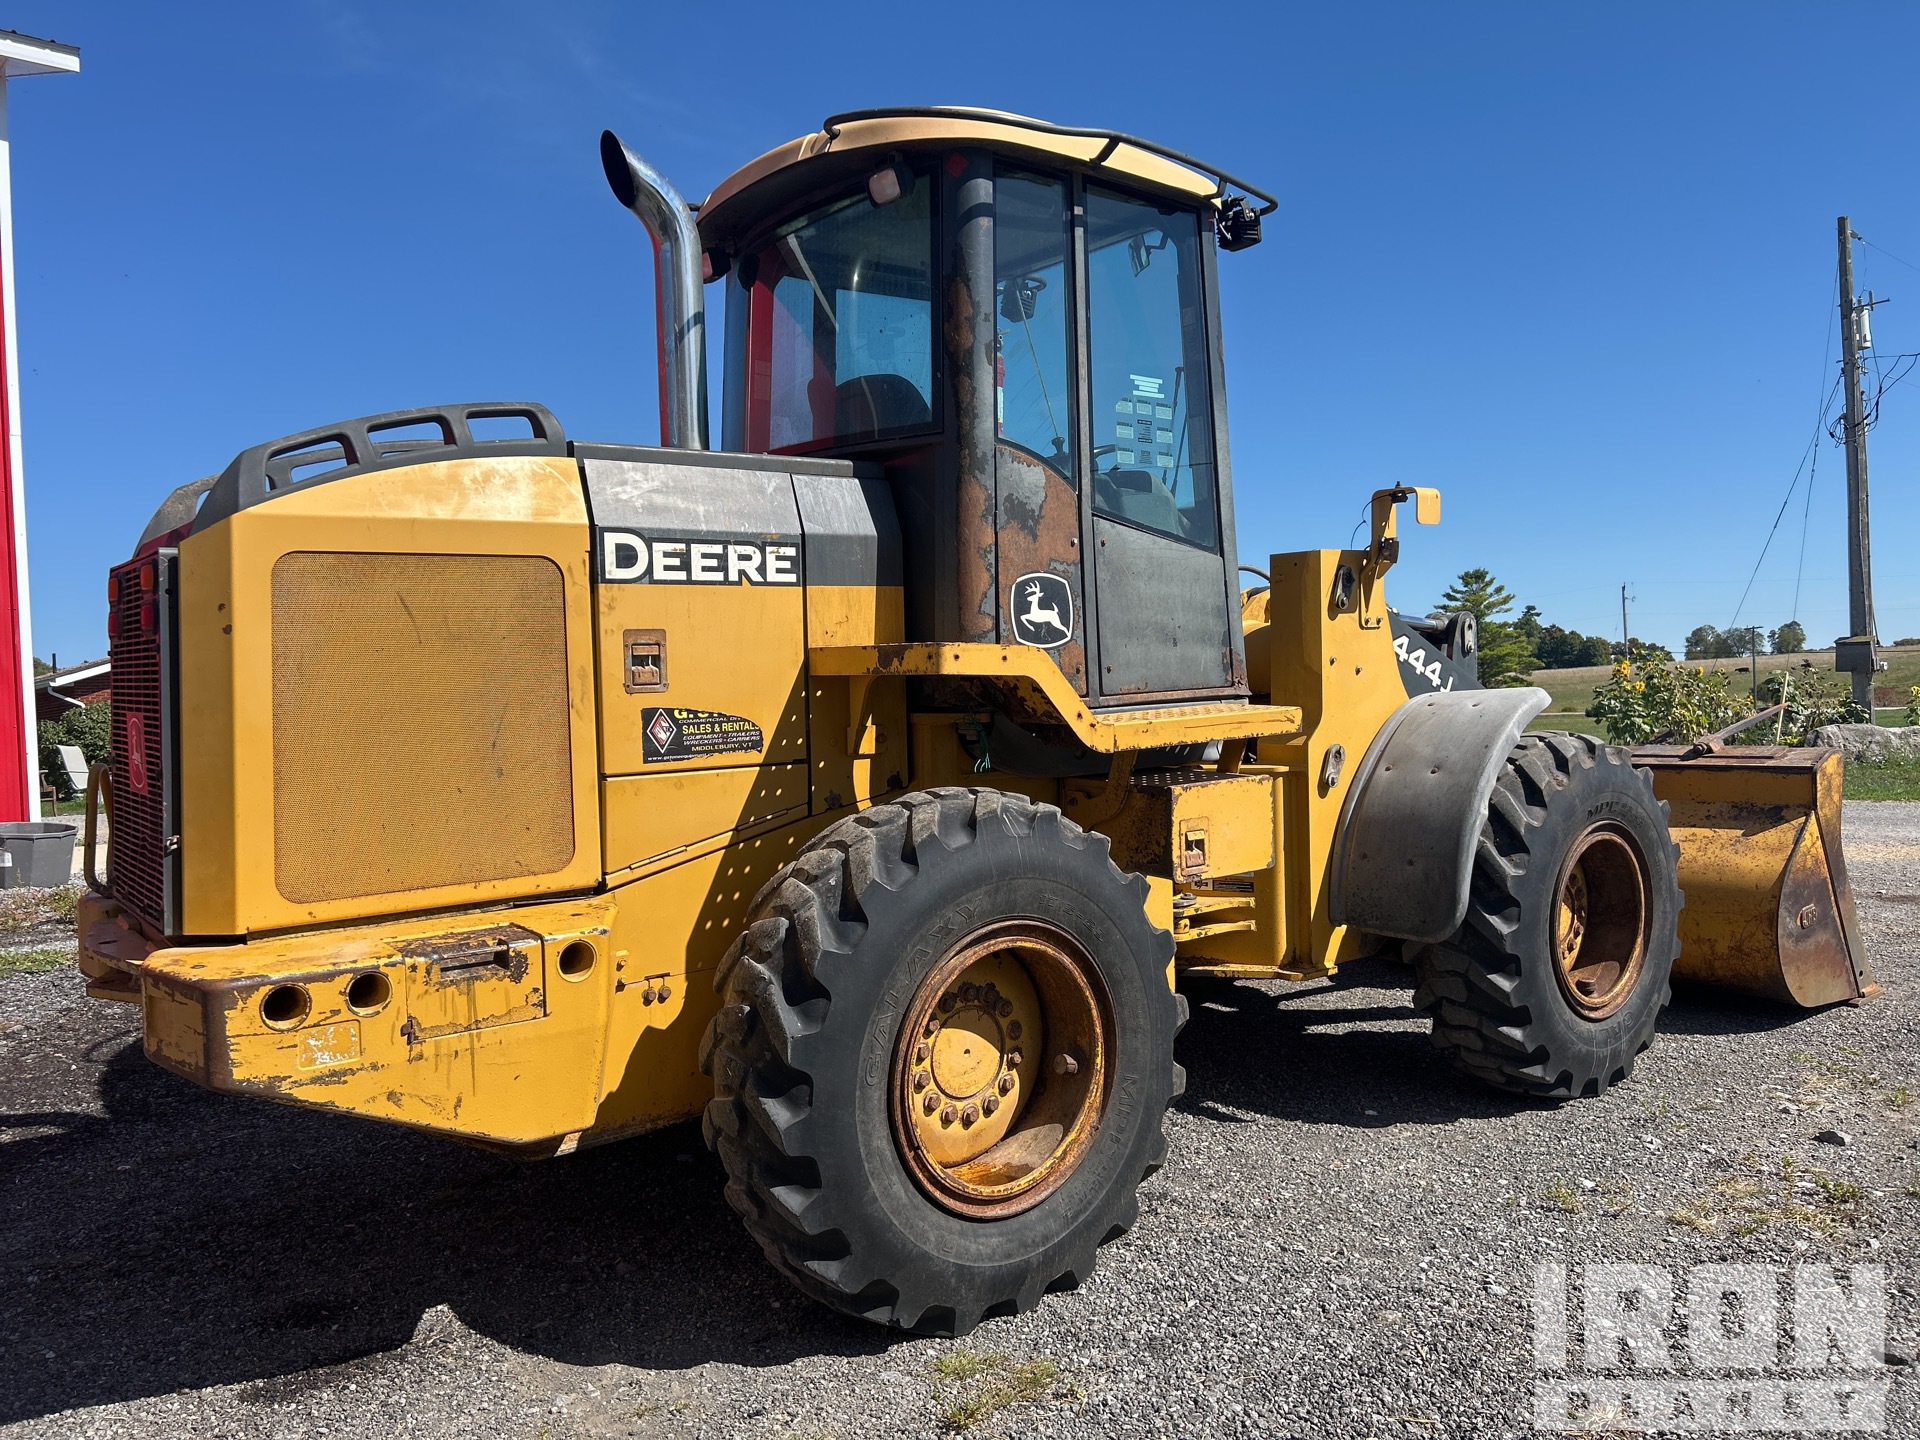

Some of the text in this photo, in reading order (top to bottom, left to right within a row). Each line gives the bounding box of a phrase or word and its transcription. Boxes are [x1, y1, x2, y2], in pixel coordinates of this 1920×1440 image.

[604, 532, 797, 583] DEERE
[682, 723, 712, 735] SALES
[714, 724, 720, 733] &
[682, 730, 760, 741] EQUIPMENT TRAILERS
[683, 738, 723, 746] WRECKERS
[864, 895, 983, 1087] GALAXY
